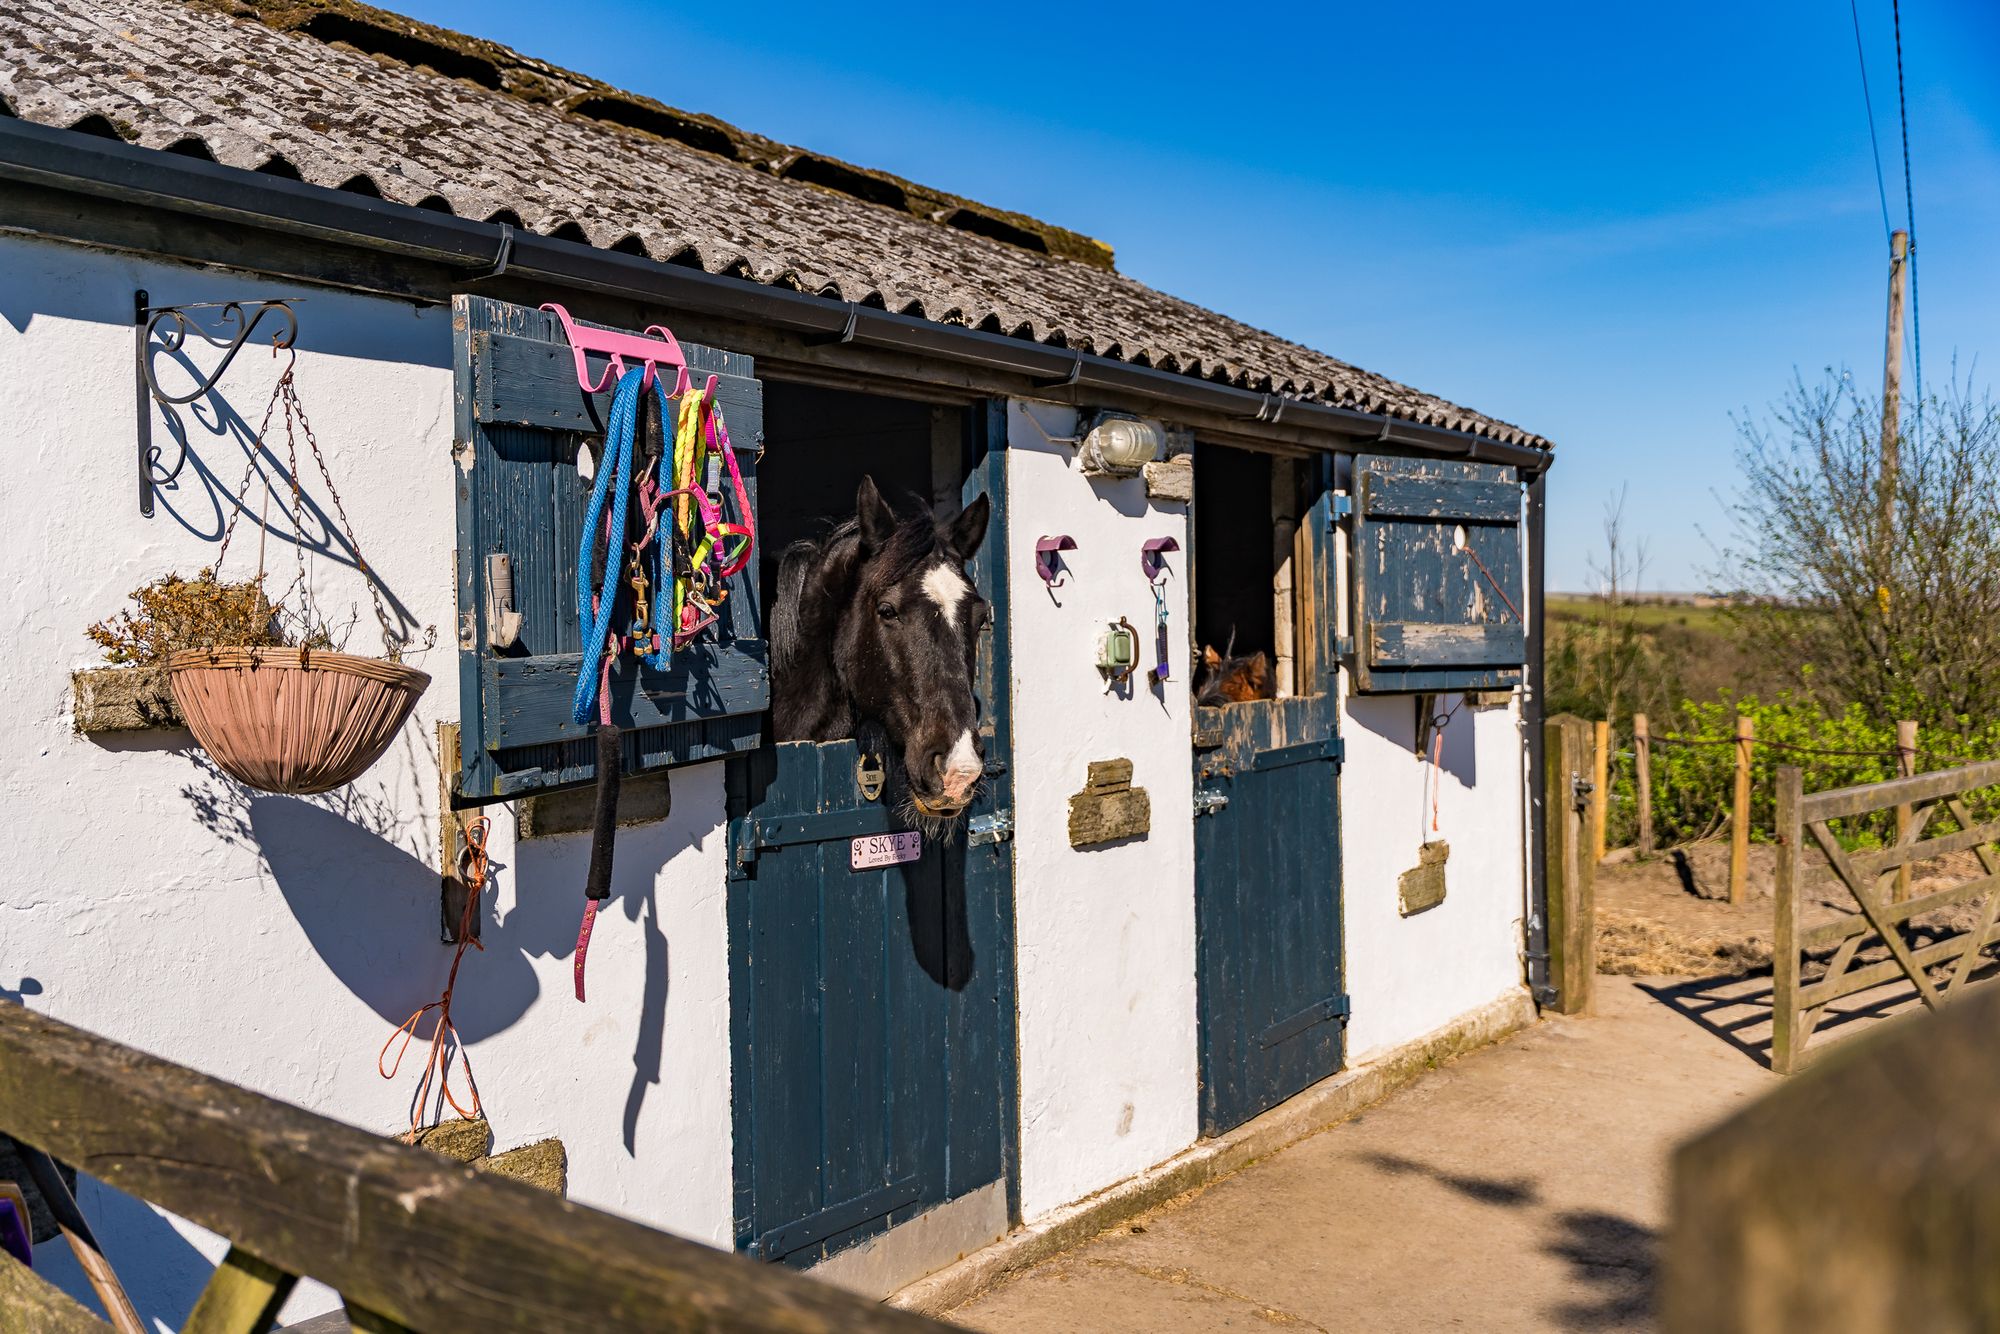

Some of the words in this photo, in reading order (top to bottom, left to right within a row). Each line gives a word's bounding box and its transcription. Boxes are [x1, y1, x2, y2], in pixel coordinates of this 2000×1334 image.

[869, 835, 905, 854] SKYE
[868, 855, 883, 863] Loved
[884, 854, 891, 862] By
